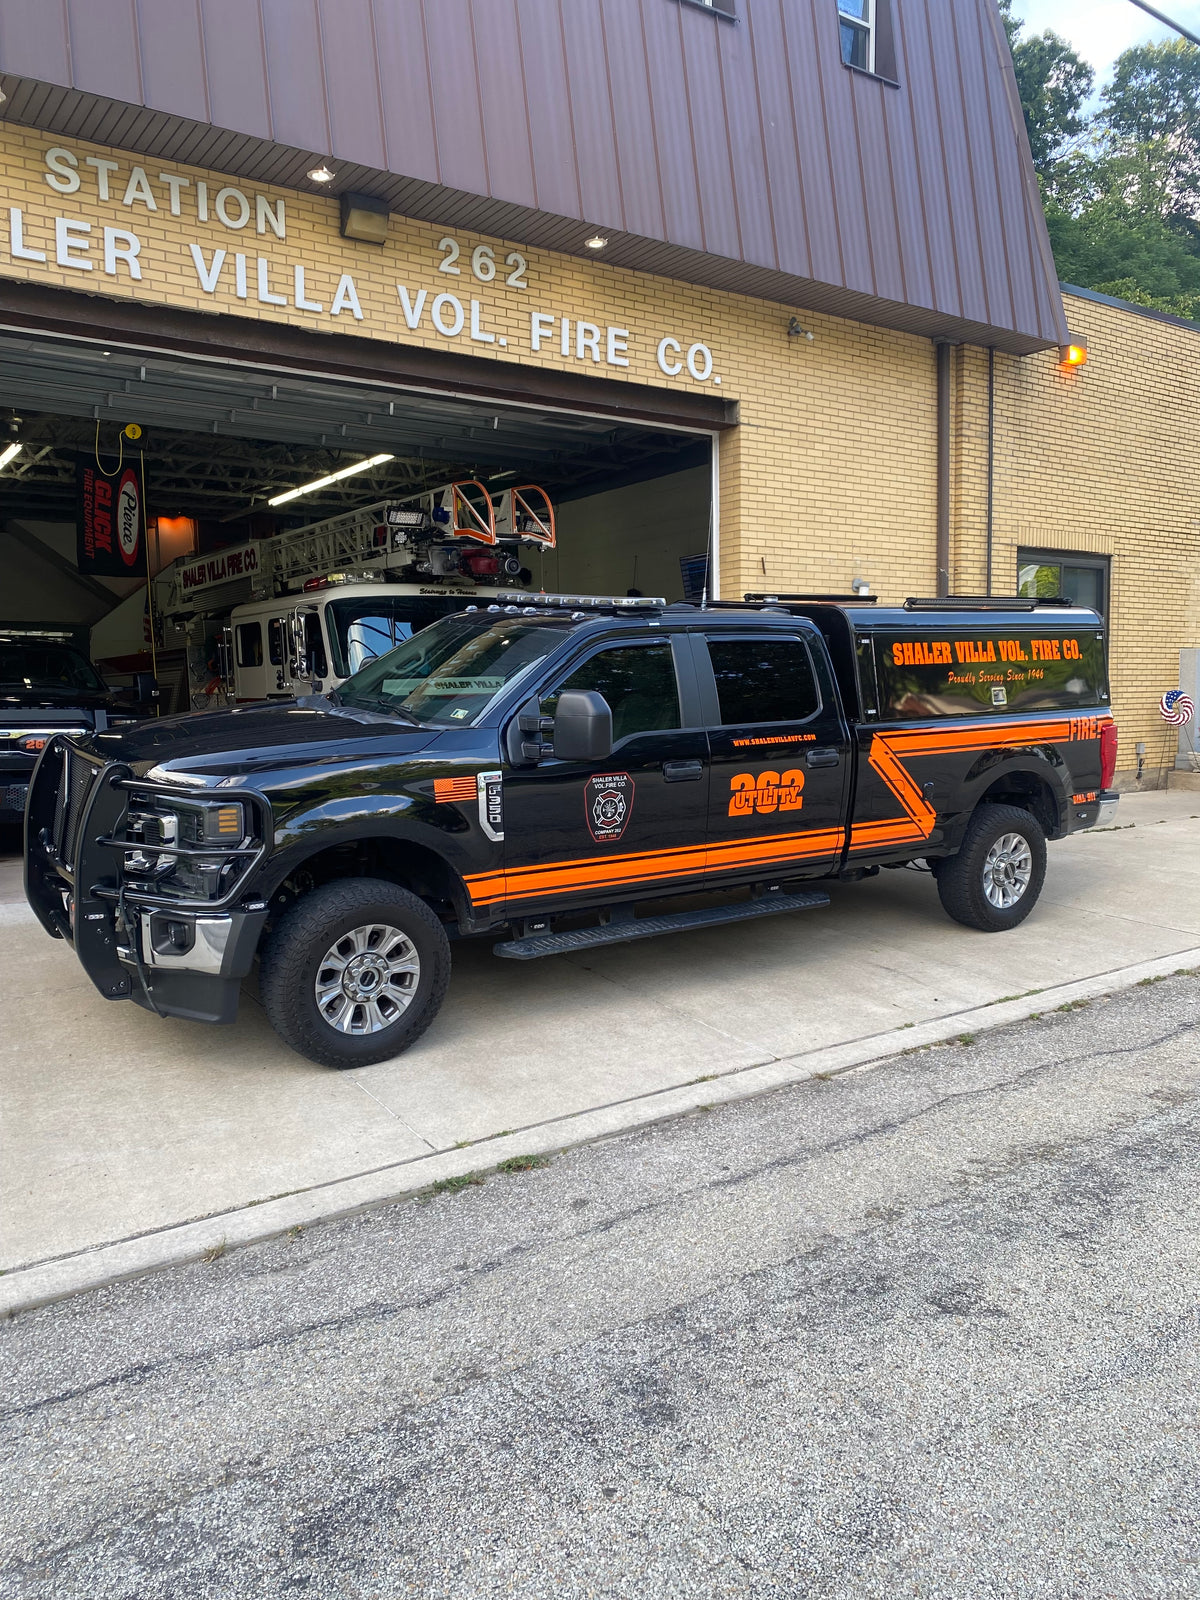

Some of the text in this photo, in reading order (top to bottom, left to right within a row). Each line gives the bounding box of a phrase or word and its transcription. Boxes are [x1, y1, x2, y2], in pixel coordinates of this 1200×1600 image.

[44, 147, 527, 289] STATION 262
[189, 243, 364, 320] VILLA
[397, 284, 507, 346] VOL.
[531, 311, 629, 366] FIRE
[656, 337, 721, 384] CO.
[83, 468, 95, 560] FIRE EQUIPMENT
[94, 479, 112, 554] GLICK
[121, 490, 138, 544] Pierce
[182, 547, 259, 589] SHALER VILLA FIRE CO.
[892, 639, 1083, 666] SHALER VILLA VOL. FIRE CO.
[947, 668, 1044, 685] Proudly Serving Since 1946
[25, 739, 47, 750] 26
[733, 734, 817, 747] WWW.SHALERVILLAVFC.COM
[728, 769, 805, 817] 262
[735, 786, 800, 810] UTILITY
